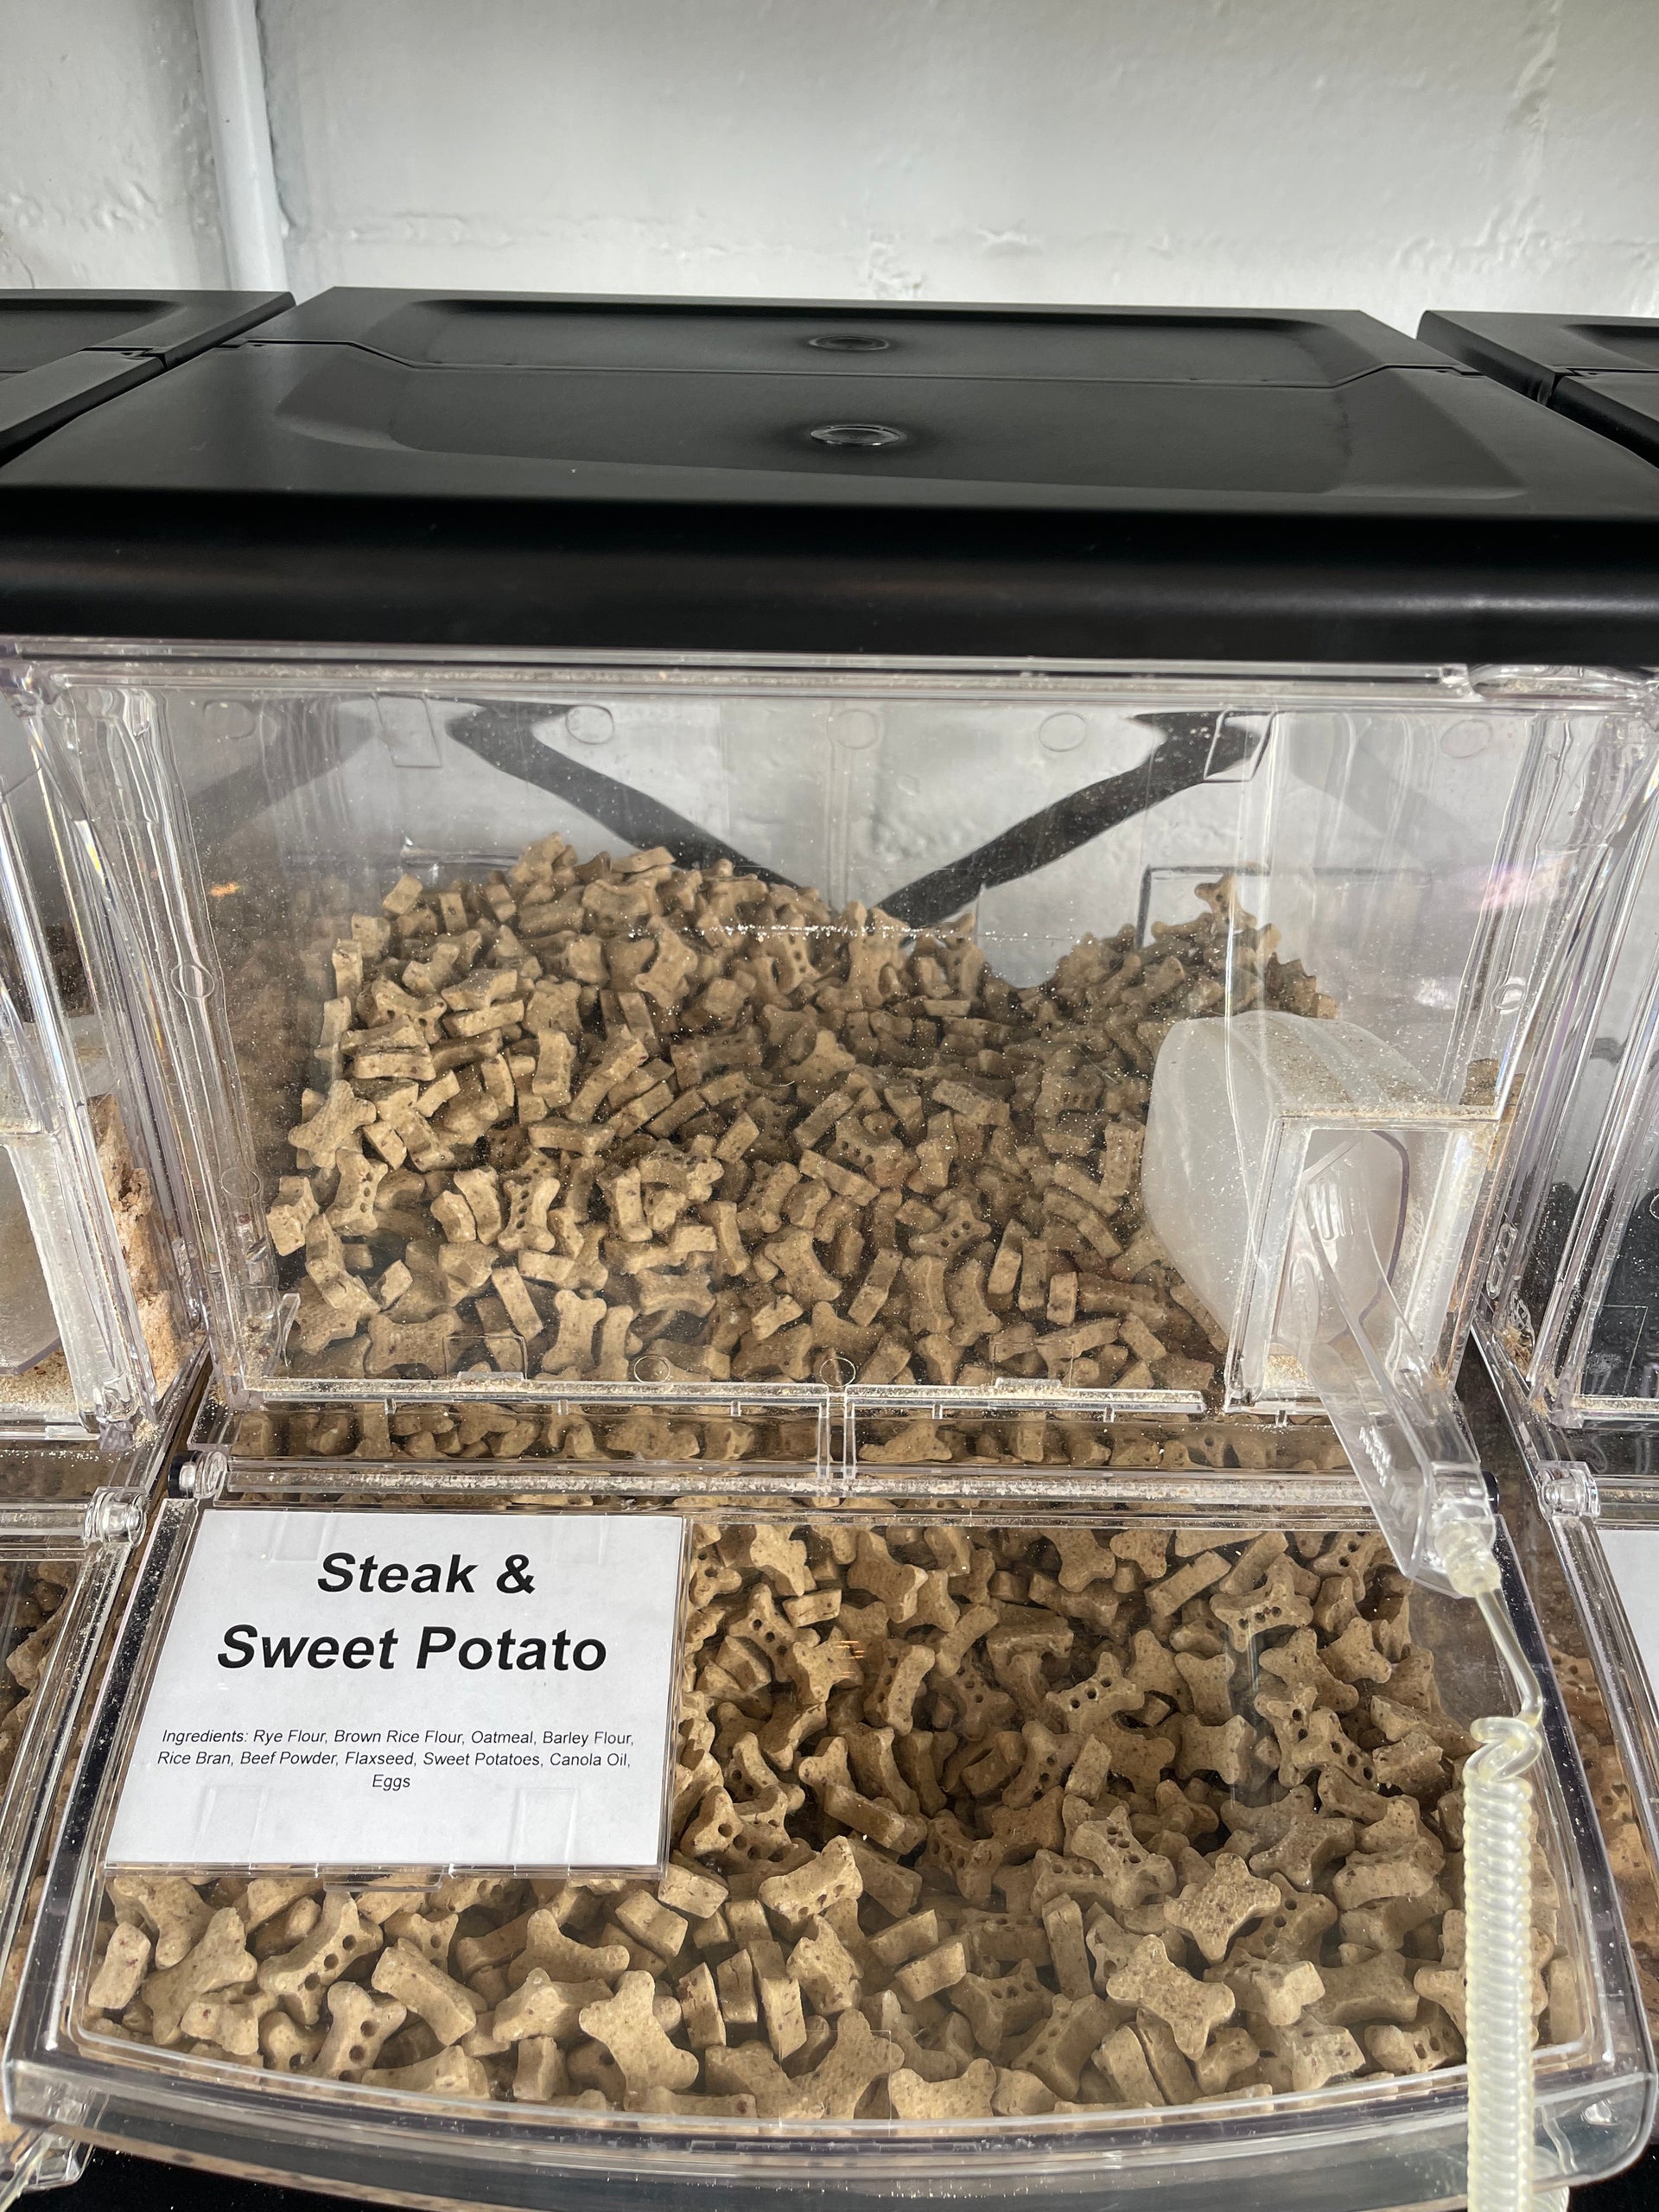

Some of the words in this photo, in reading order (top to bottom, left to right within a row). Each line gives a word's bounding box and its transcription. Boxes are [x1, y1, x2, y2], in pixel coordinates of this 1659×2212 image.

[318, 1553, 479, 1594] Steak
[496, 1554, 536, 1595] &
[218, 1624, 398, 1669] Sweet
[416, 1626, 607, 1671] Potato
[162, 1729, 249, 1746] Ingredients:
[253, 1730, 283, 1746] Rye
[288, 1730, 328, 1745] Flour,
[334, 1730, 382, 1744] Brown
[386, 1730, 420, 1744] Rice
[425, 1730, 465, 1746] Flour,
[471, 1731, 537, 1746] Oatmeal,
[543, 1731, 589, 1748] Barley
[594, 1732, 634, 1747] Flour,
[157, 1751, 192, 1765] Rice
[196, 1751, 234, 1767] Bran,
[240, 1751, 277, 1765] Beef
[280, 1751, 339, 1767] Powder,
[345, 1751, 416, 1768] Flaxseed,
[423, 1752, 471, 1766] Sweet
[475, 1752, 543, 1768] Potatoes,
[550, 1753, 602, 1767] Canola
[607, 1753, 631, 1769] Oil,
[372, 1774, 410, 1792] Eggs
